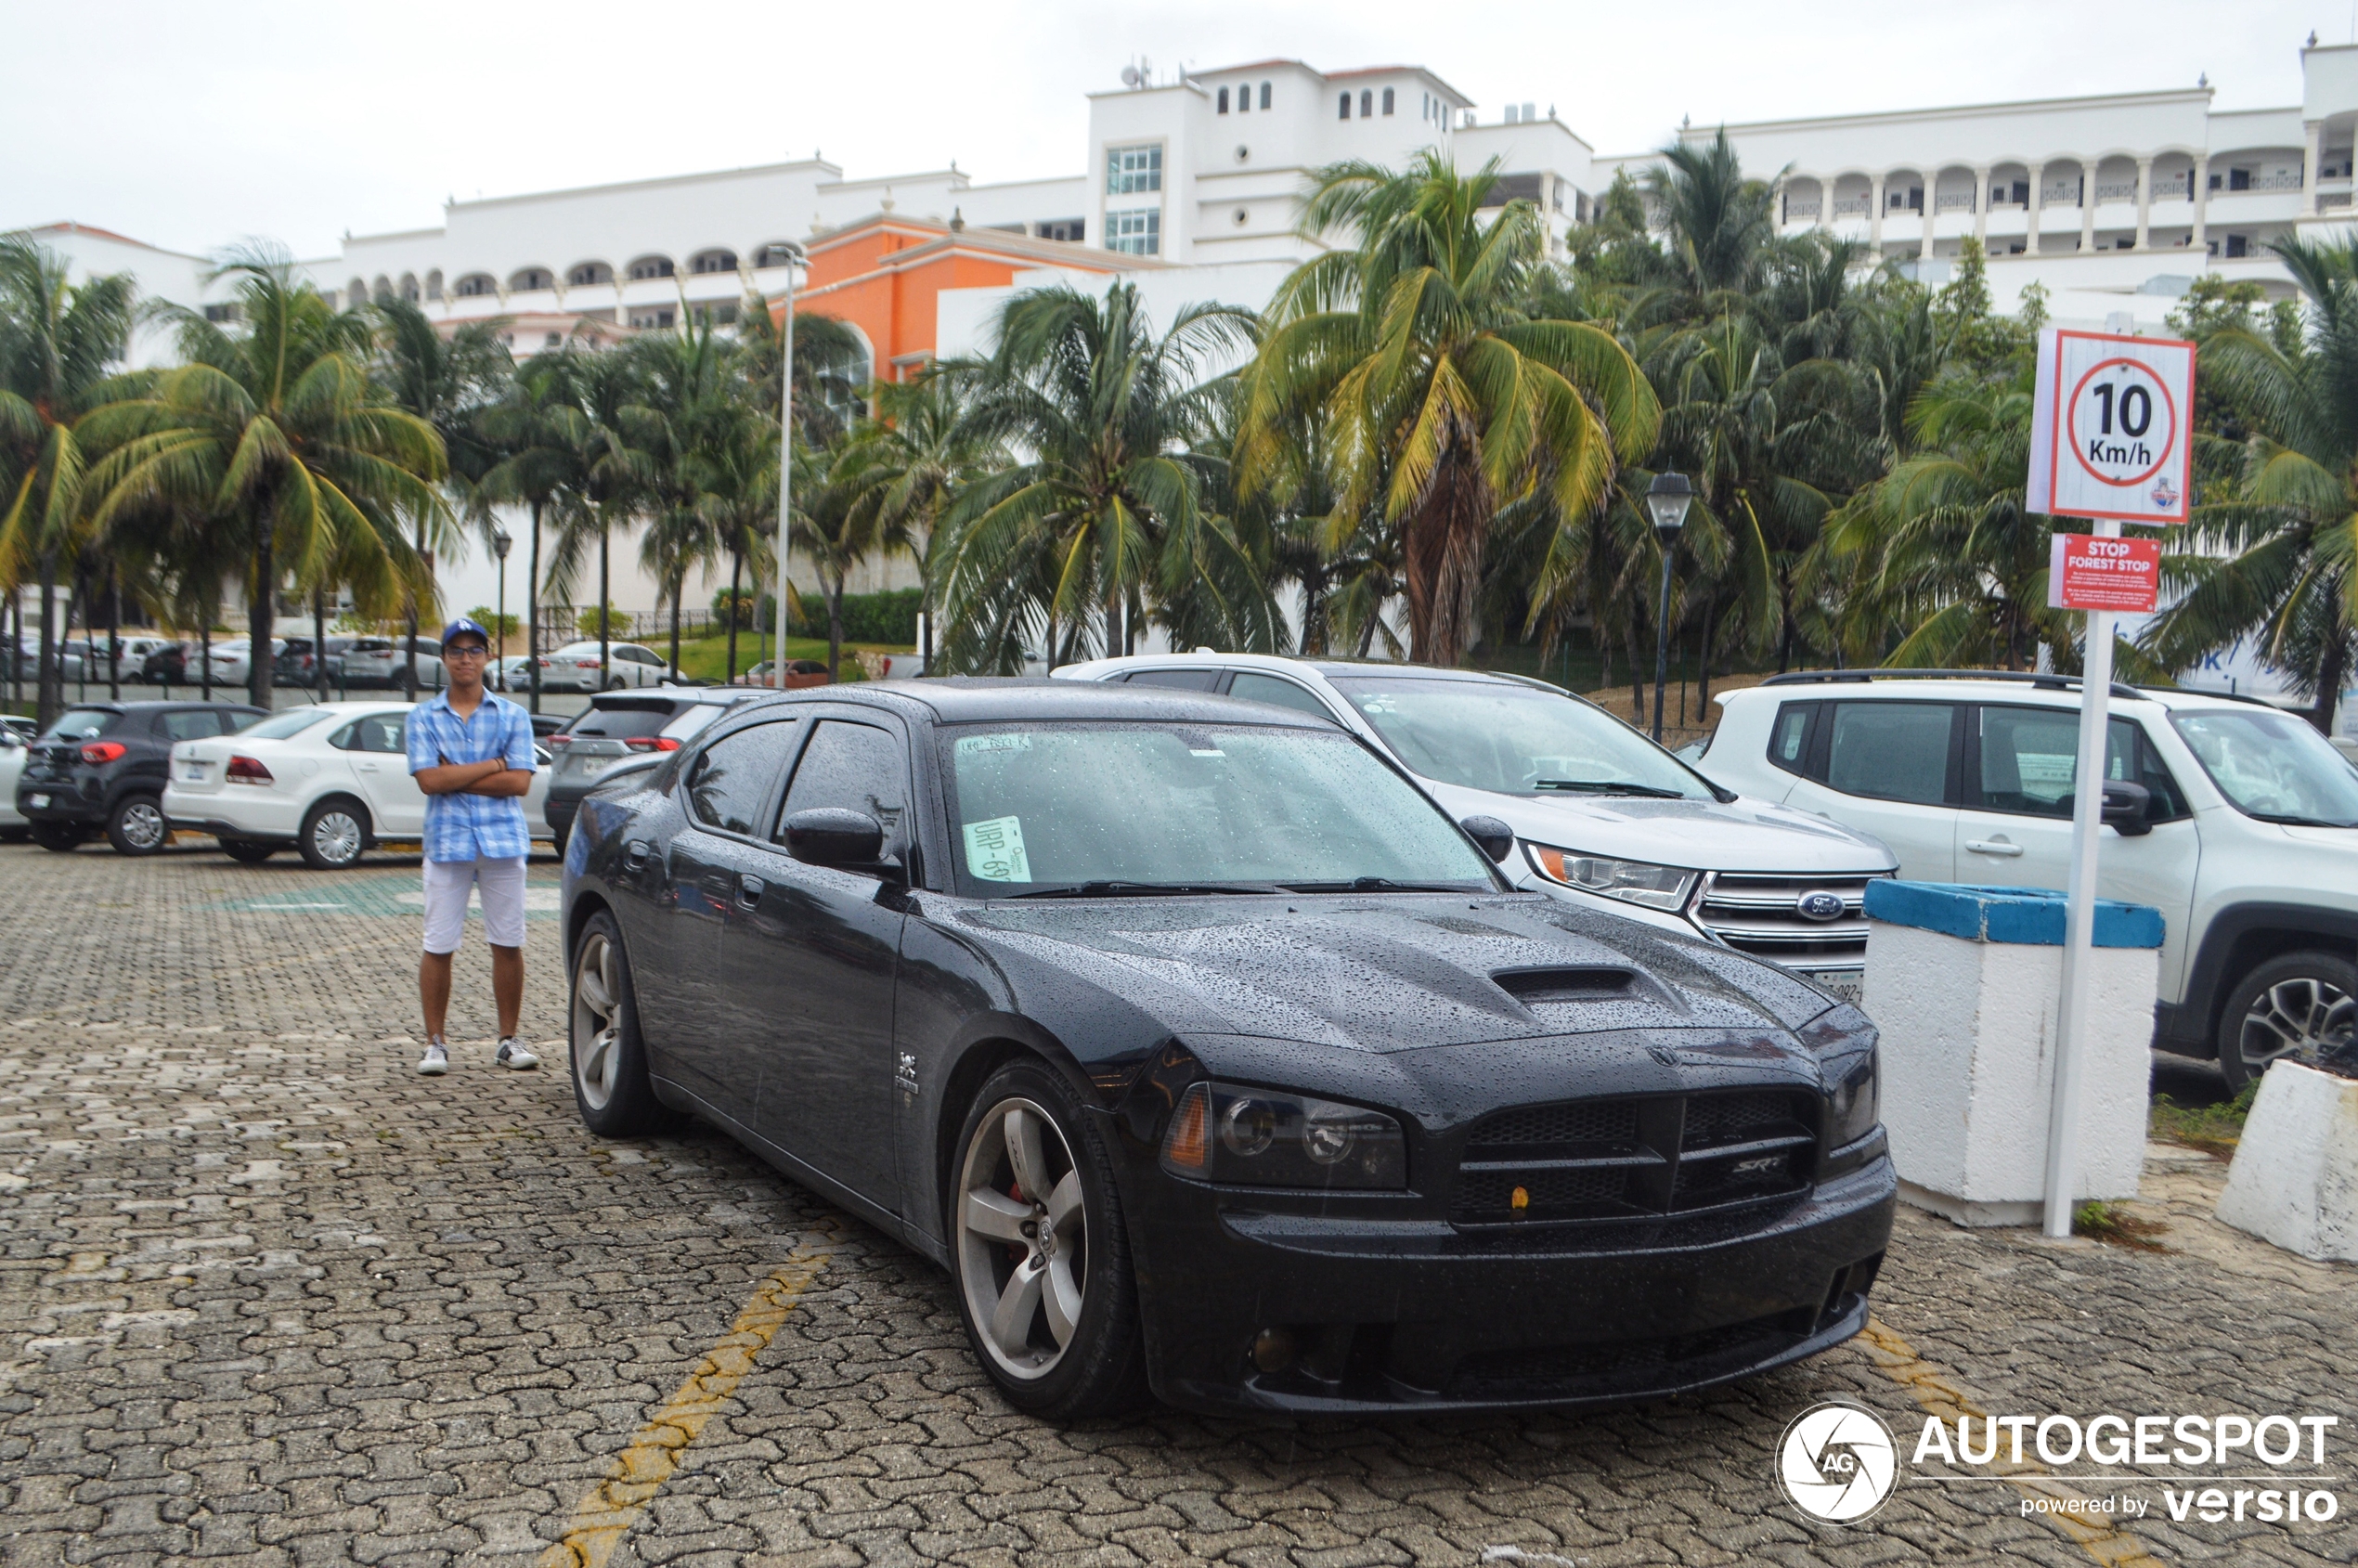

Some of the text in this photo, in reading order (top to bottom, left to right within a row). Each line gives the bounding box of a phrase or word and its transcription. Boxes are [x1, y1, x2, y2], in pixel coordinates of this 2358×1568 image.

[2092, 382, 2152, 437] 10
[2089, 439, 2152, 465] Km/h
[2087, 541, 2131, 557] STOP
[2068, 555, 2151, 572] FOREST STOP
[1812, 897, 1837, 913] Ford
